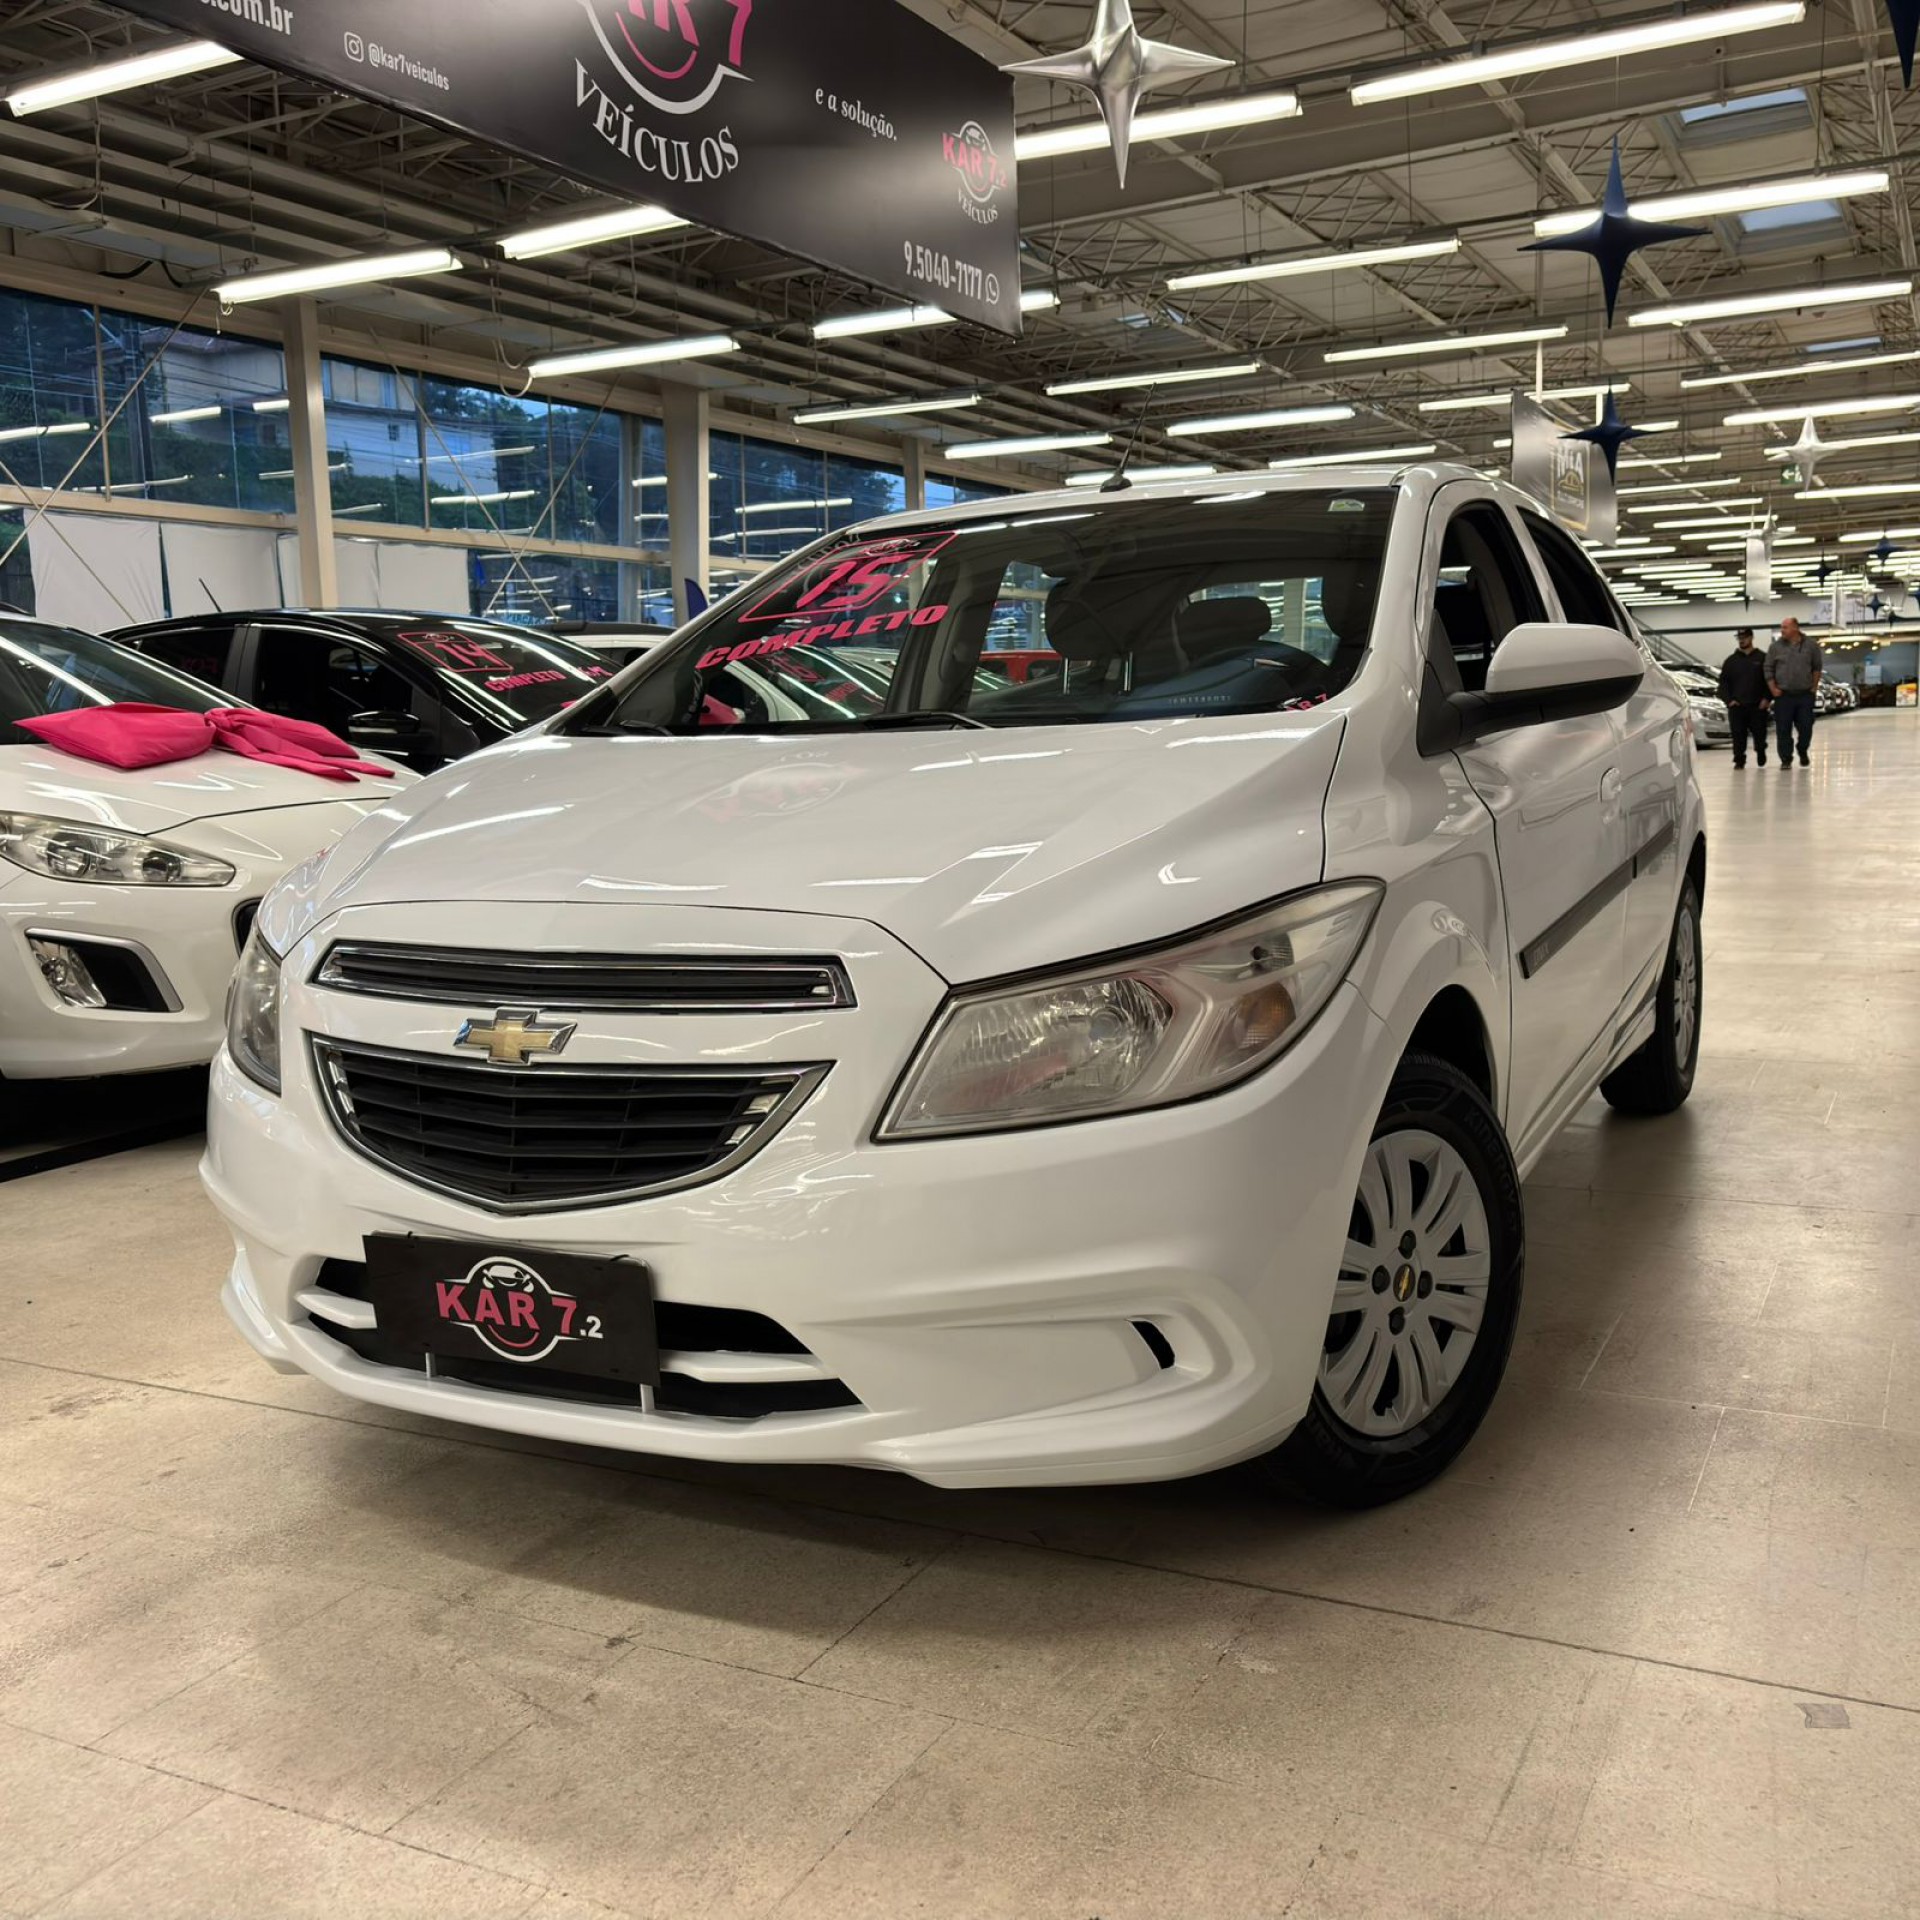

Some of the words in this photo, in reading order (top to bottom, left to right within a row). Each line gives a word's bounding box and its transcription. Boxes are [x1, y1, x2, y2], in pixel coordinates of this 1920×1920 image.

[368, 42, 450, 91] @kar7veiculos
[575, 57, 740, 184] VEÍCULOS
[827, 93, 838, 113] a
[841, 99, 898, 142] solução.
[903, 240, 983, 300] 9.5040-7177
[796, 553, 916, 610] 15
[694, 604, 950, 671] COMPLETO
[484, 670, 568, 693] COMPLETO
[436, 1281, 541, 1331] KAR
